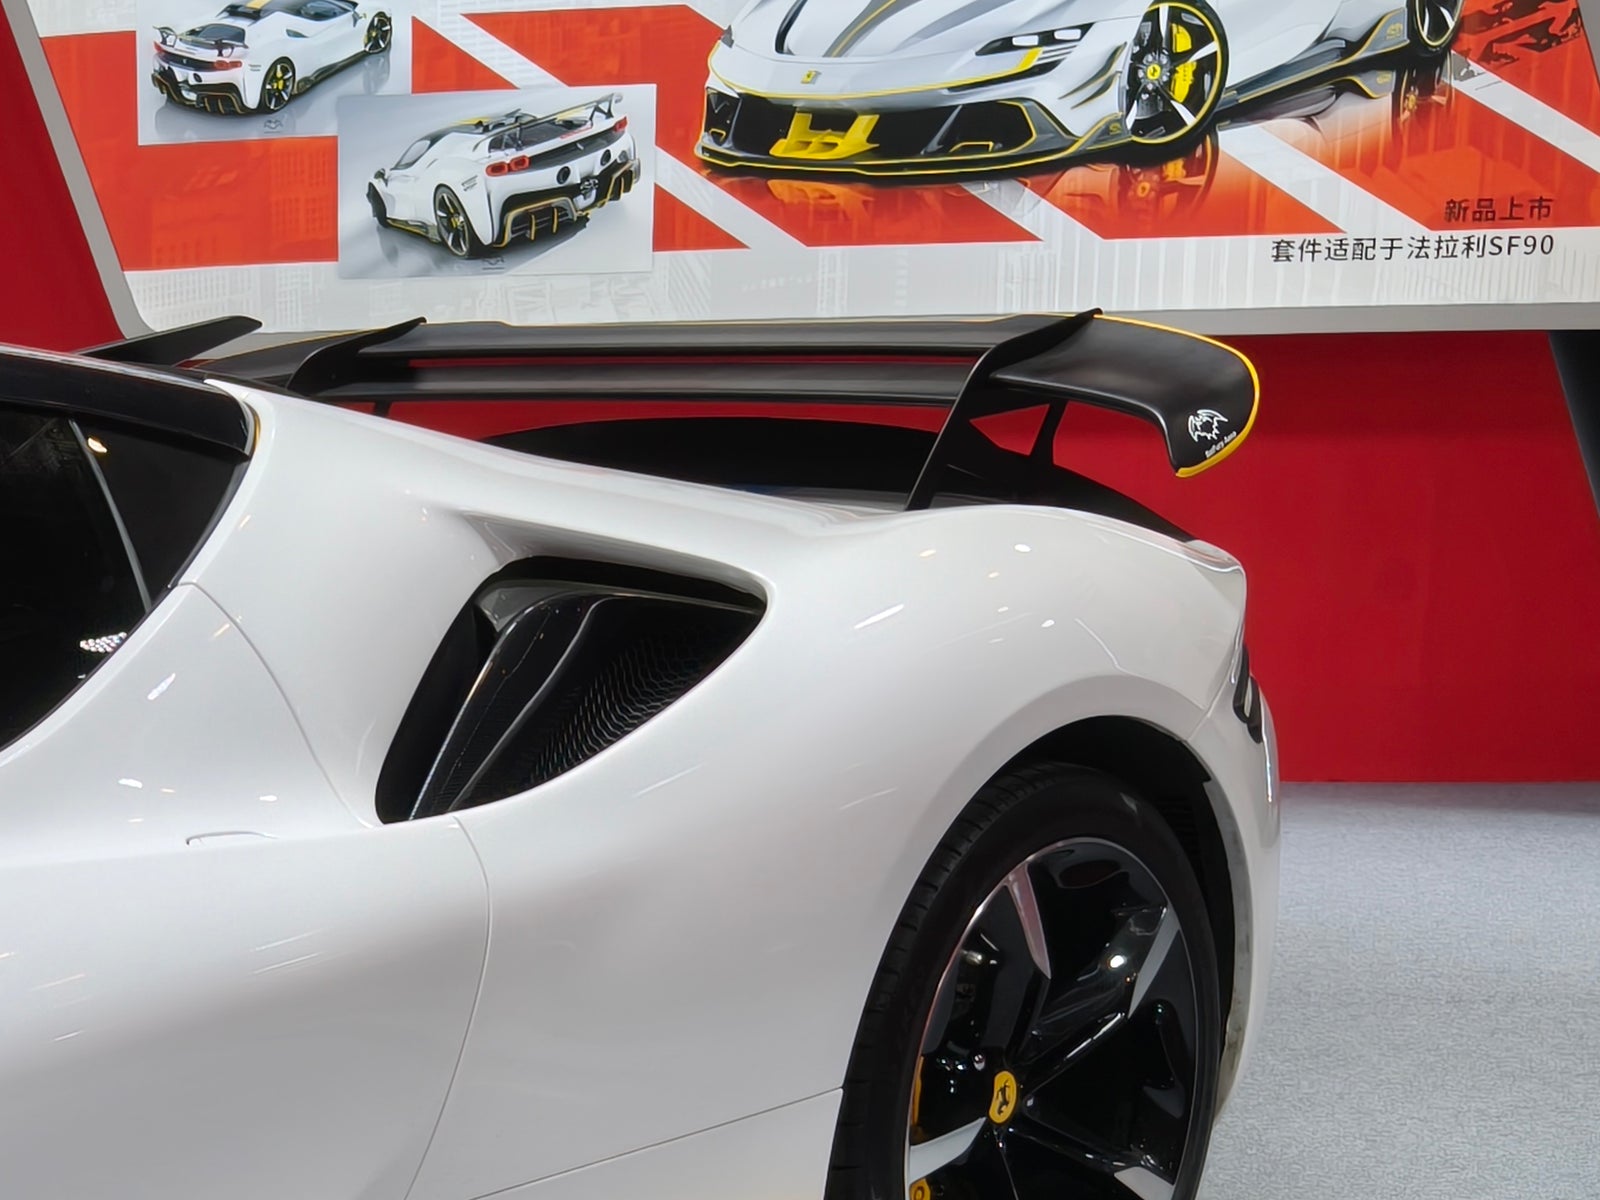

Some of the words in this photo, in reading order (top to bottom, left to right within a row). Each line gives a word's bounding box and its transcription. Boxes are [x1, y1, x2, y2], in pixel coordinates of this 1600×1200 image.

[1443, 196, 1555, 223] 新品上市
[1271, 234, 1555, 264] 套件适配于法拉利SF90
